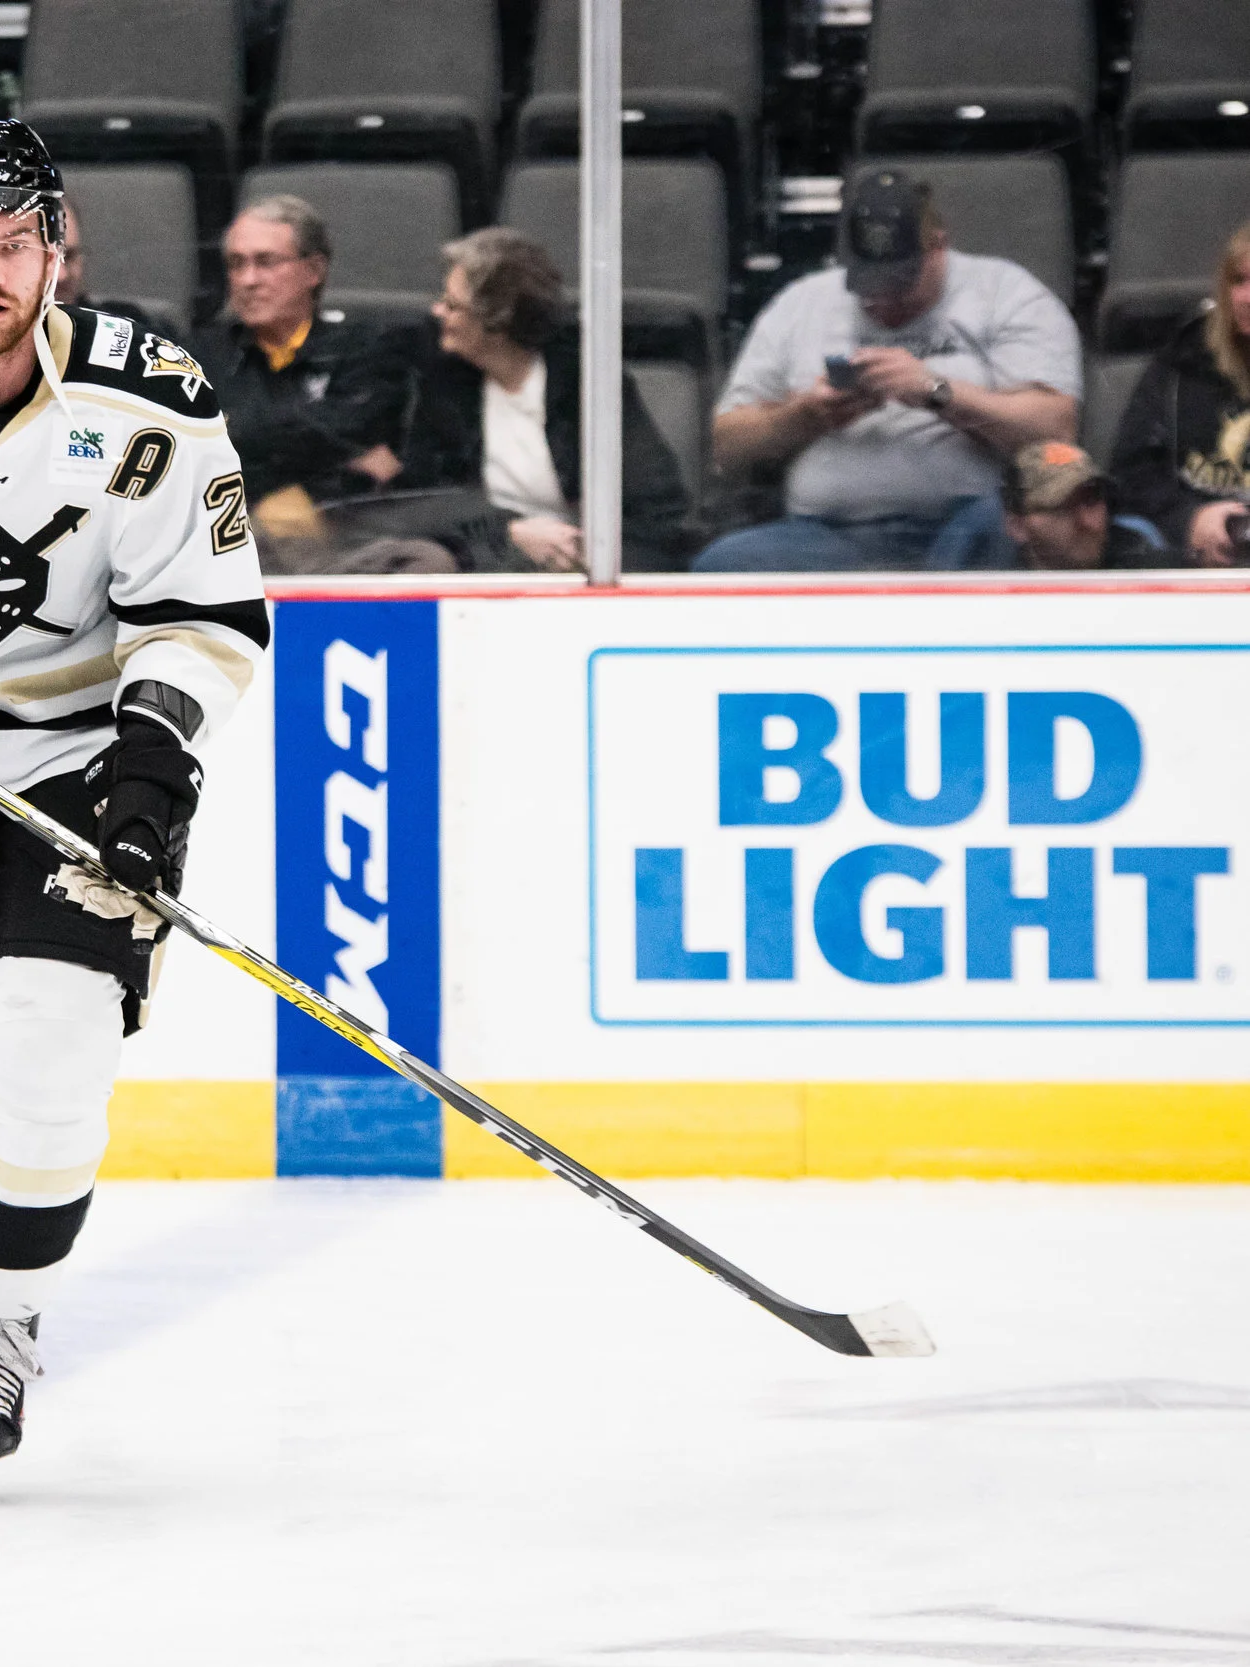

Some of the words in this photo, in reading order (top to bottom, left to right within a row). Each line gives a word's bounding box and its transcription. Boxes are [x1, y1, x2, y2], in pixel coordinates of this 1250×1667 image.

[105, 427, 176, 500] A
[718, 690, 1143, 829] BUD
[116, 842, 152, 862] CCM
[324, 638, 389, 1040] CCM
[635, 843, 1231, 986] LIGHT
[293, 994, 366, 1047] TACKS
